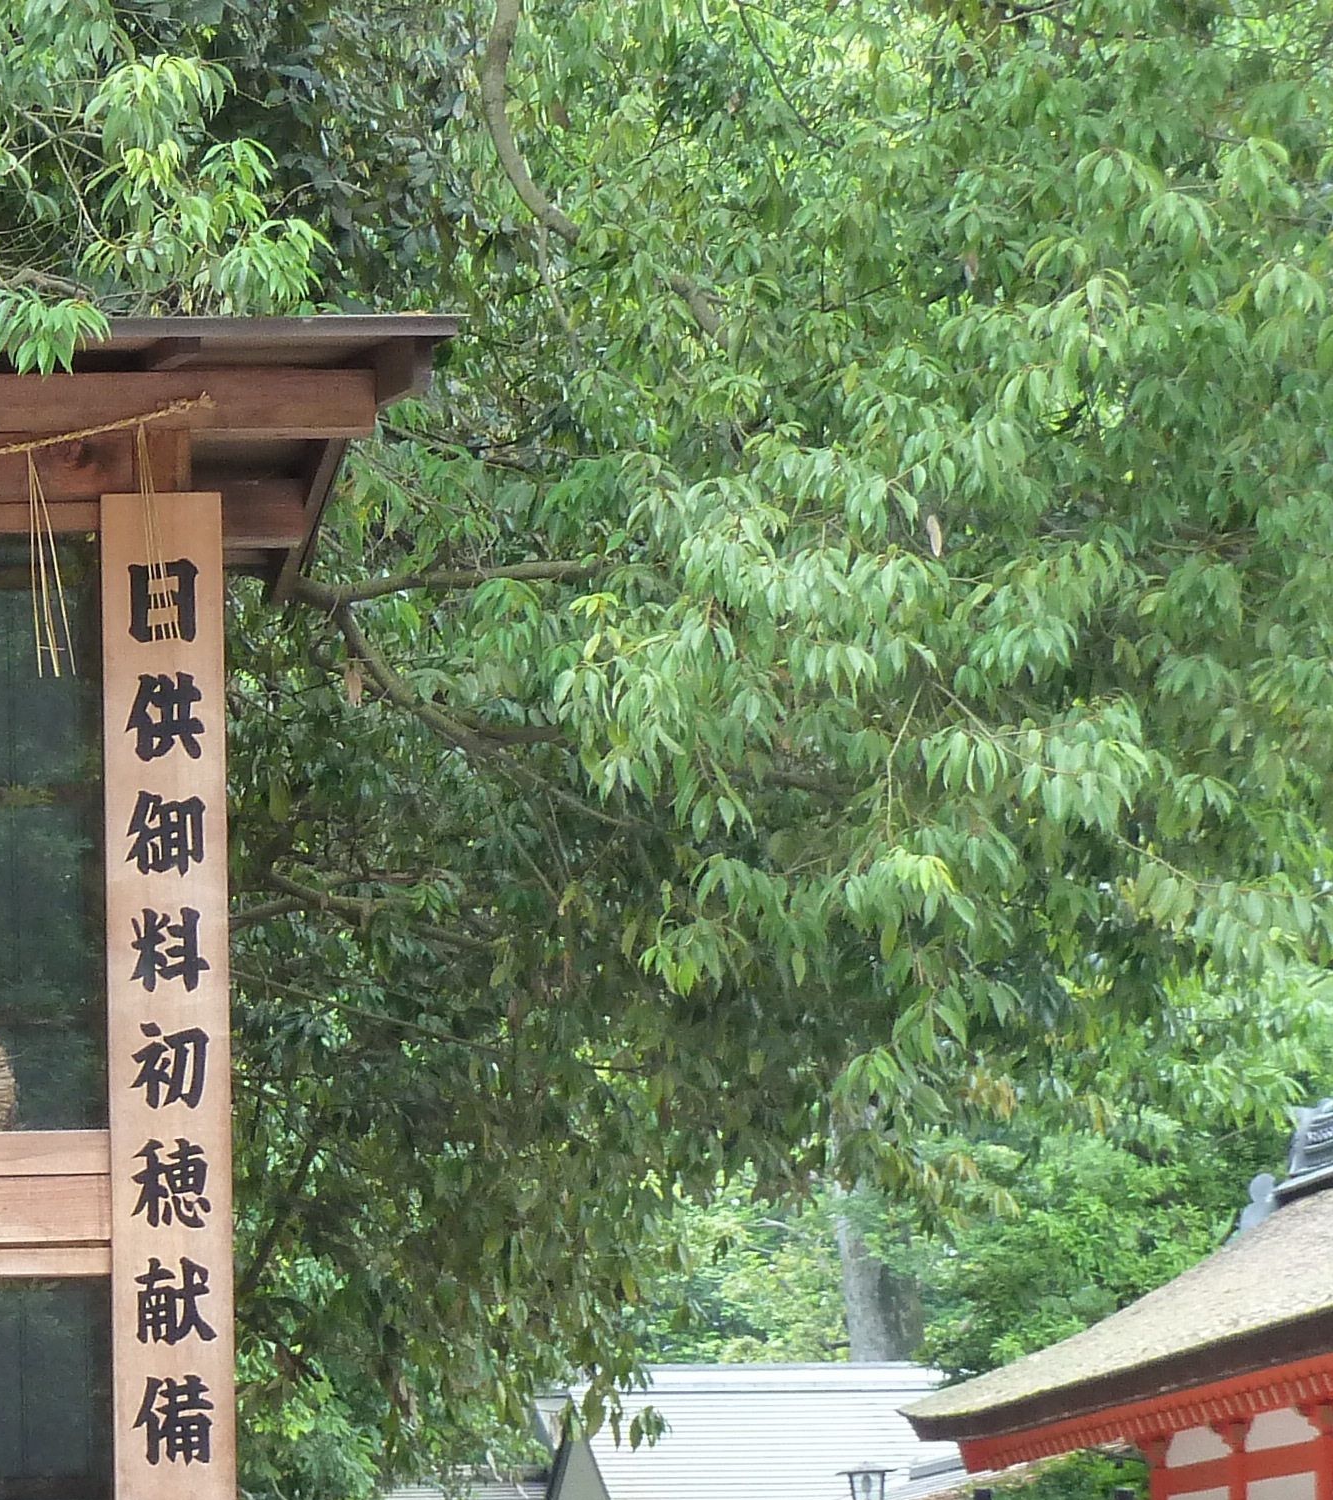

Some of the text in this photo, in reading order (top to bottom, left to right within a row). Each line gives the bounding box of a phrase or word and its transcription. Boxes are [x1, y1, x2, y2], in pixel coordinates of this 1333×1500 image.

[125, 556, 216, 1466] 日供御料初穂献備
